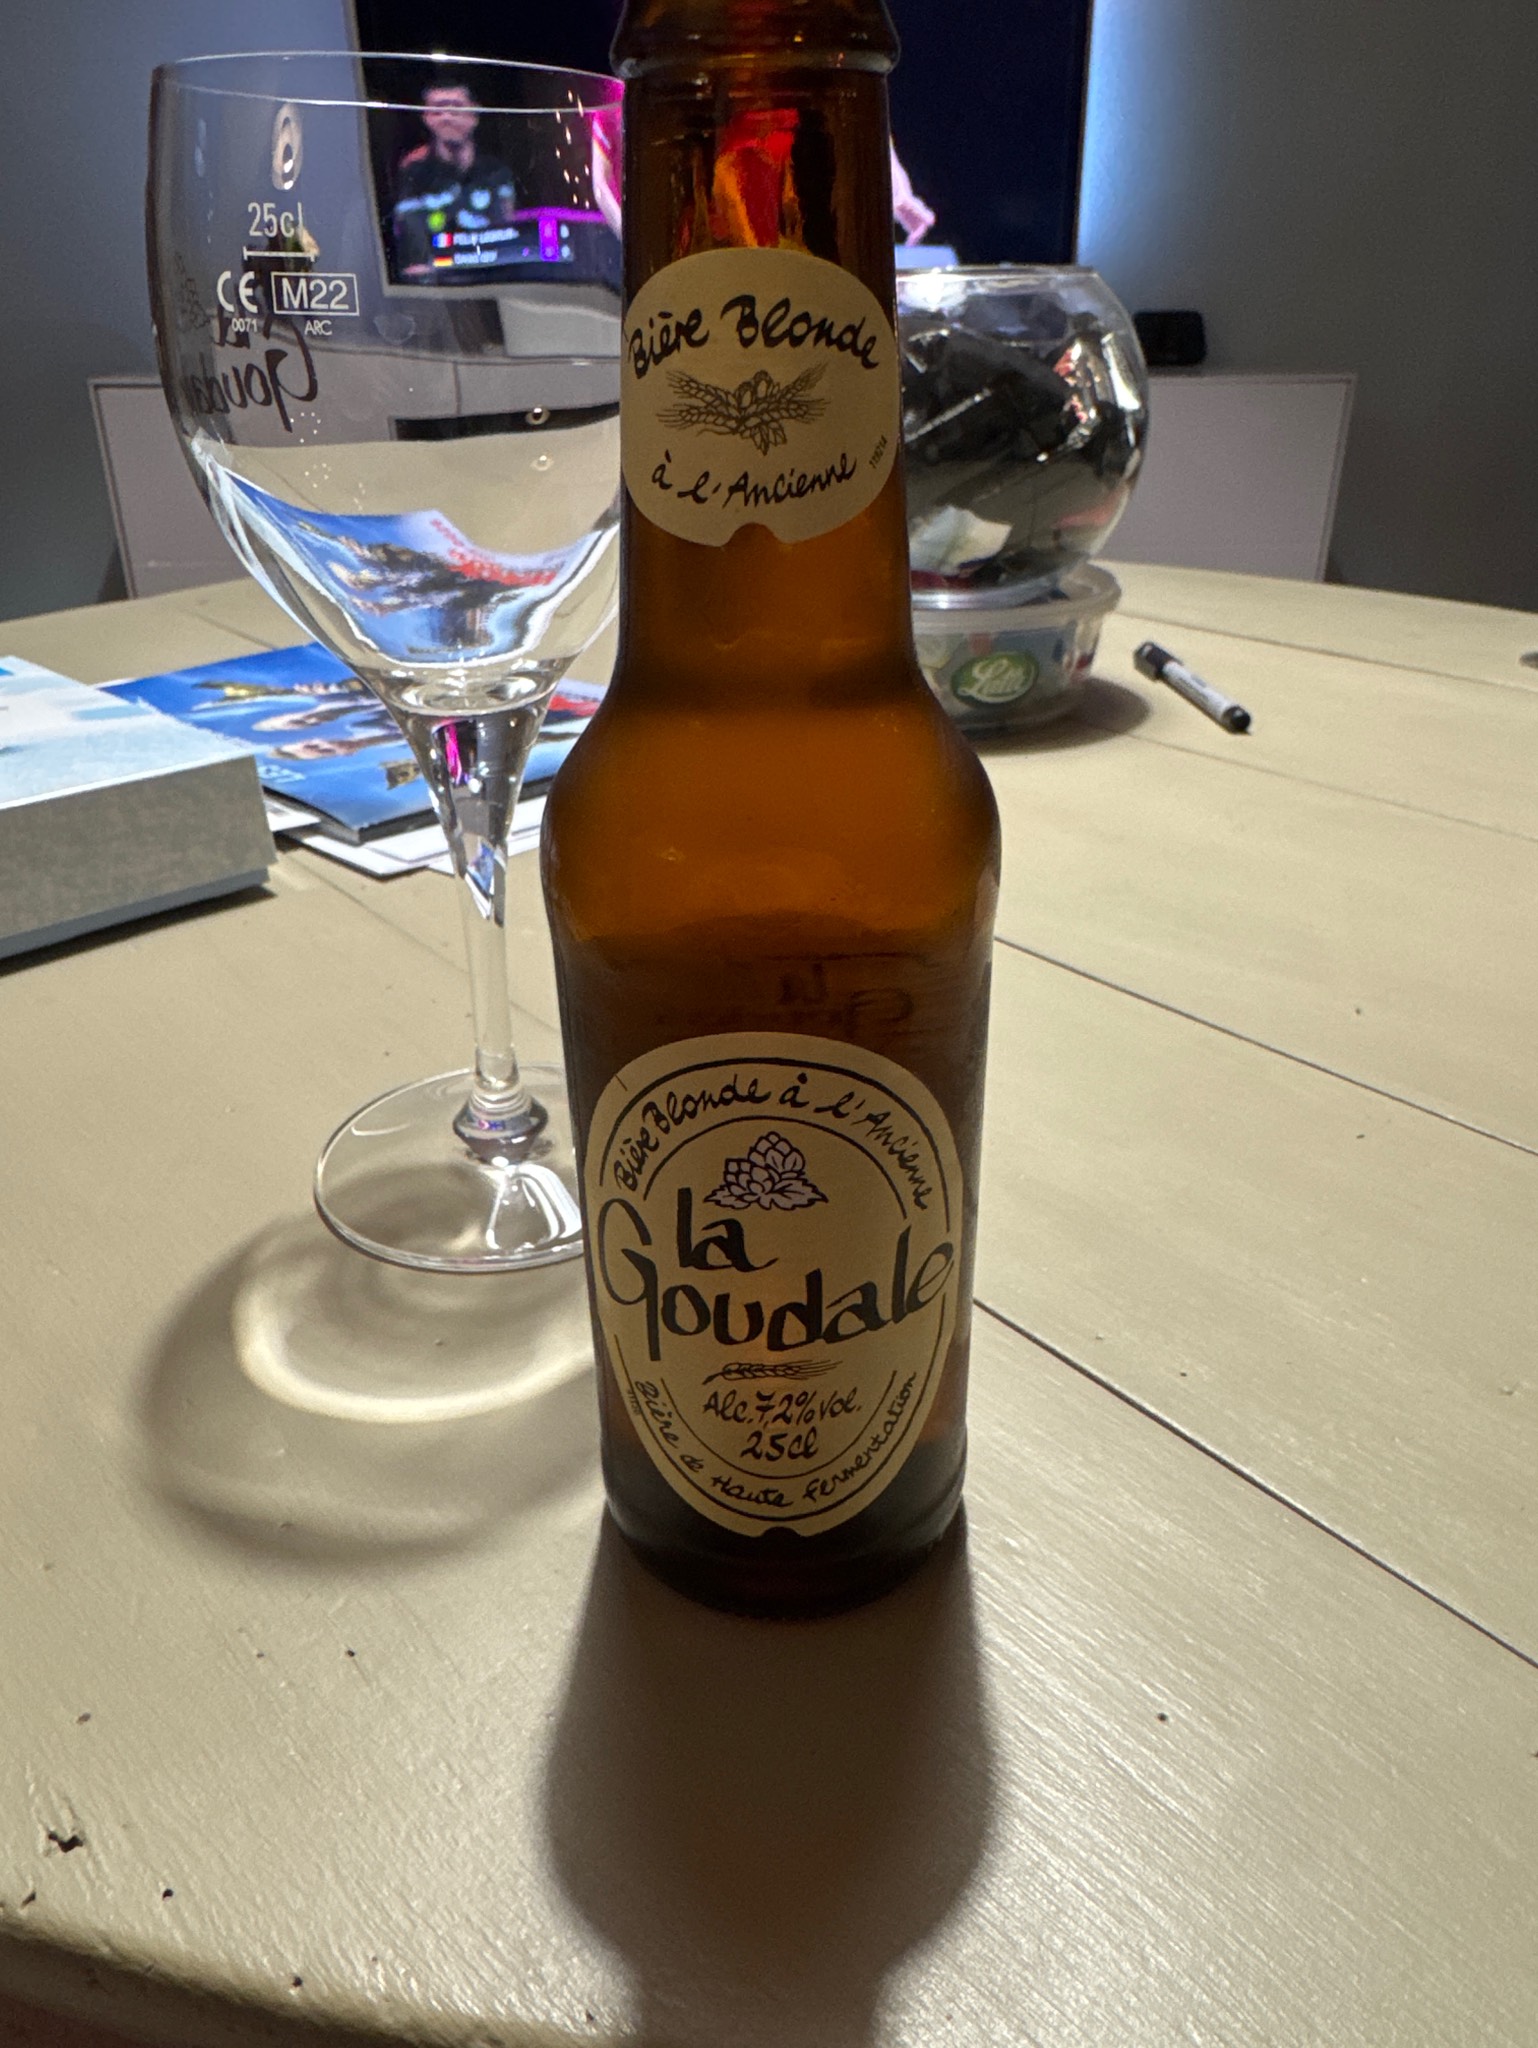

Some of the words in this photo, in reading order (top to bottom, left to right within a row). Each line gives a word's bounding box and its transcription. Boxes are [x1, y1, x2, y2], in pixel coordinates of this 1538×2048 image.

[247, 201, 303, 238] 25cl
[231, 317, 258, 333] 0071
[304, 319, 333, 336] ARC
[281, 277, 350, 310] M22
[628, 308, 710, 380] Bière
[720, 294, 880, 370] Blonde
[651, 449, 672, 490] à
[677, 452, 857, 509] l'Ancienne
[613, 1127, 660, 1192] Bière
[641, 1073, 772, 1135] Blonde
[778, 1072, 810, 1109] à
[813, 1091, 933, 1211] l'Ancienne
[678, 1187, 779, 1273] la
[598, 1198, 955, 1362] Goudale
[634, 1381, 680, 1450] Bière
[679, 1454, 705, 1473] de
[711, 1475, 794, 1508] Haute
[803, 1371, 917, 1504] Fermentation
